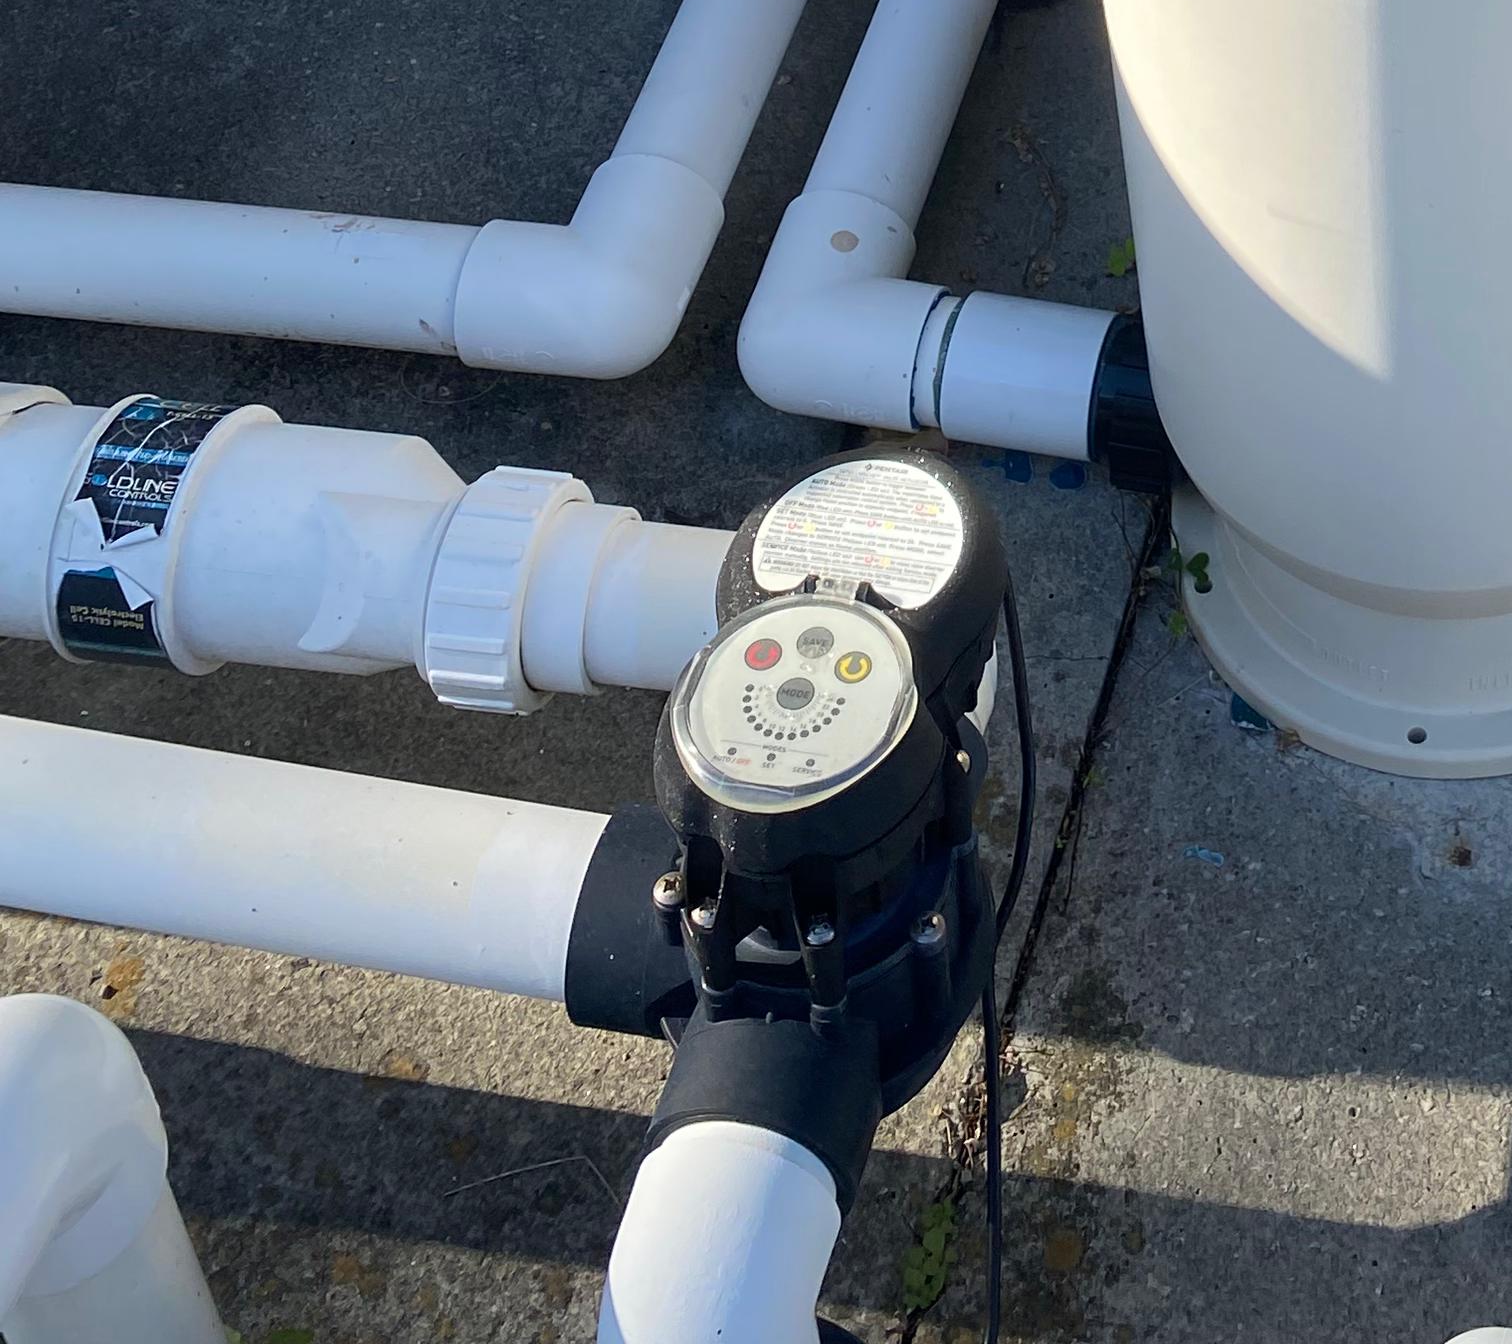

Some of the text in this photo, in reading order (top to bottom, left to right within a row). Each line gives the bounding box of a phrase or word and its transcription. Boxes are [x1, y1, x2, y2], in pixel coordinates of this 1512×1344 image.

[874, 464, 909, 473] PENTAIR
[109, 488, 174, 502] CONTROLS
[70, 605, 144, 622] Electrolytic Cell
[113, 619, 144, 630] Model
[782, 688, 811, 699] MODE
[762, 744, 787, 753] MODES
